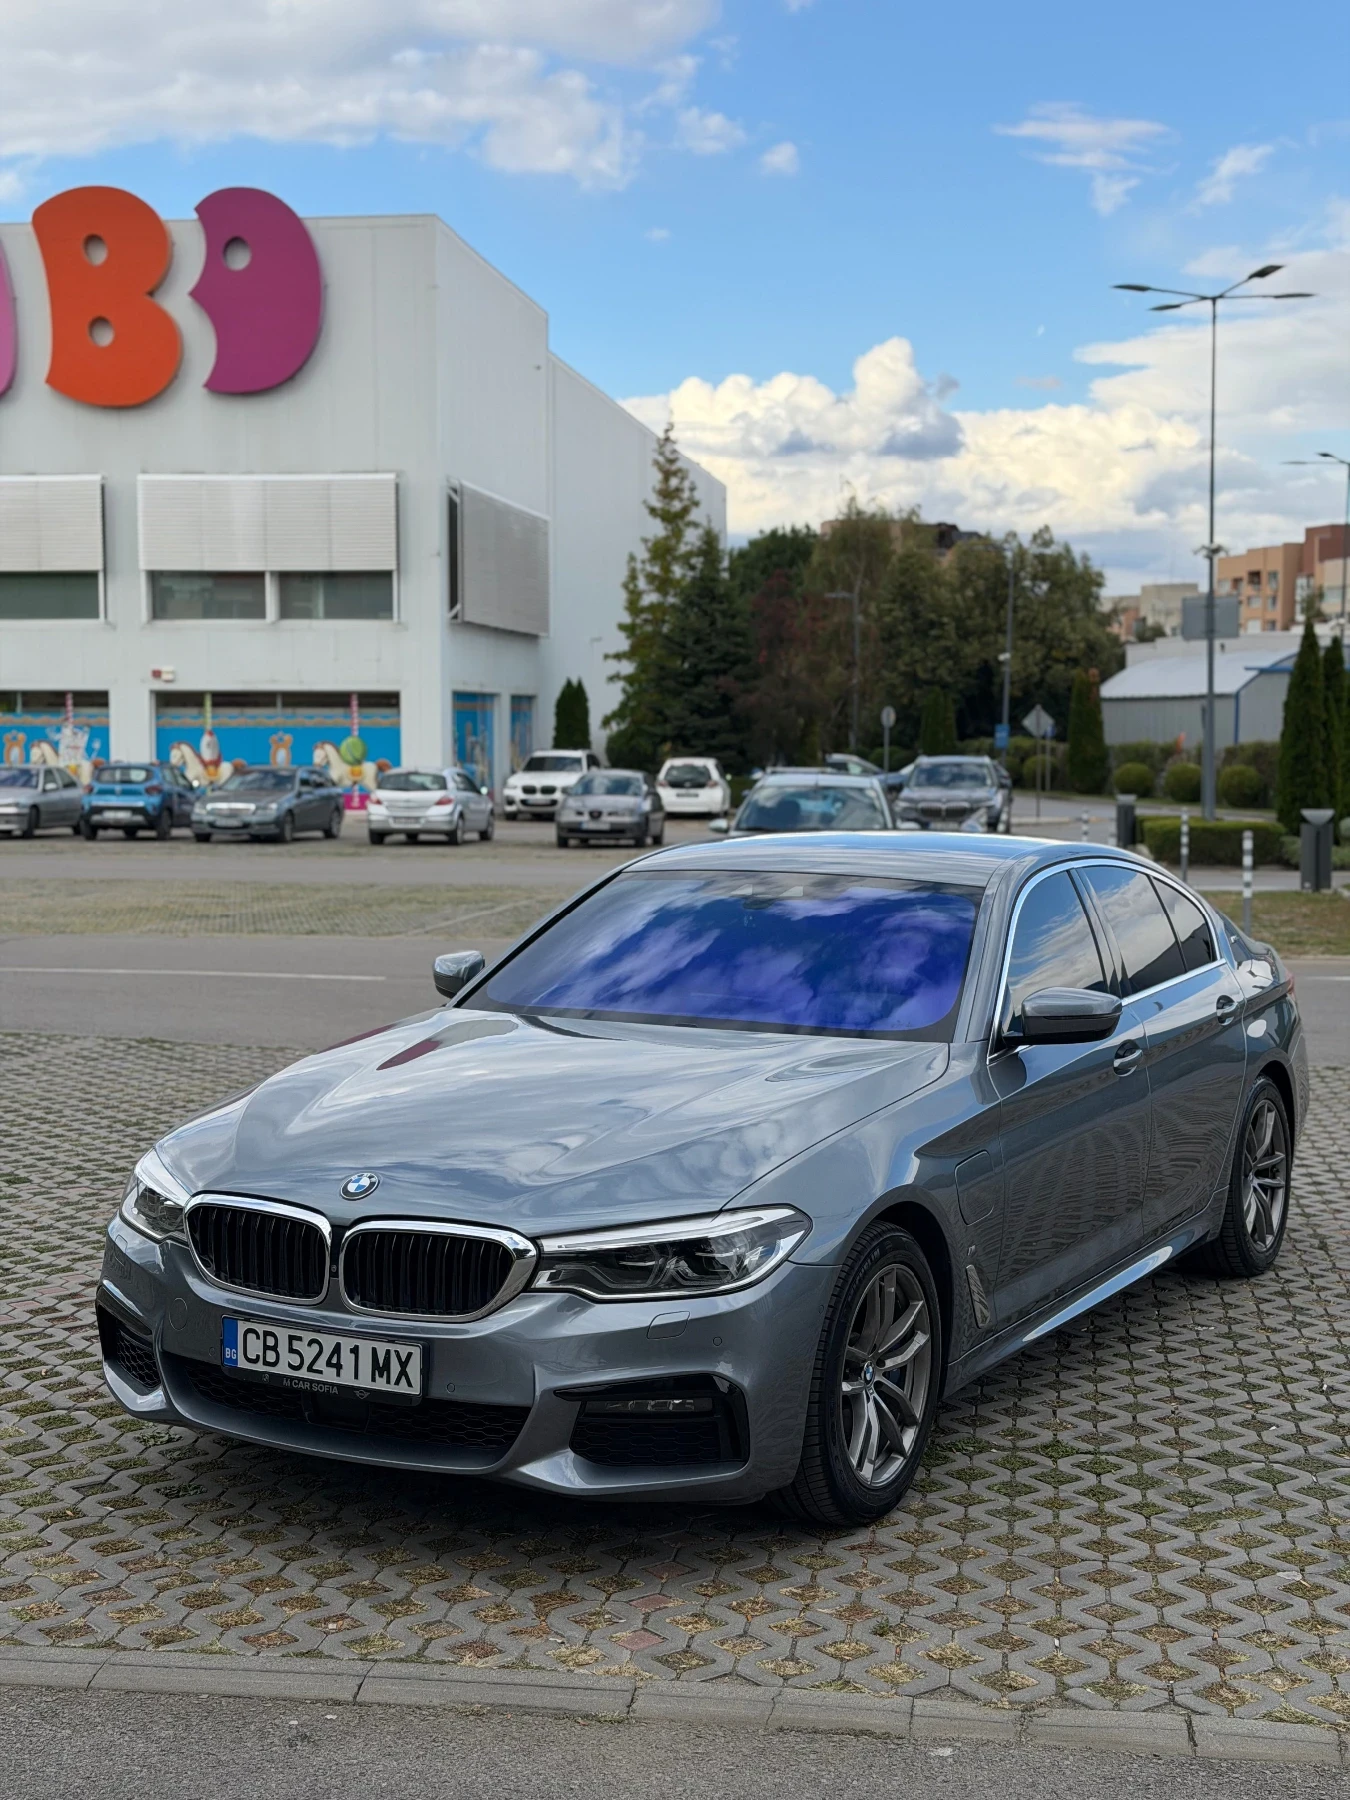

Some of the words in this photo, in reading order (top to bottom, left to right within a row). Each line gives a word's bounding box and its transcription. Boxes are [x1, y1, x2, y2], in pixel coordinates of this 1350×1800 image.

[225, 1347, 237, 1359] BG
[242, 1327, 280, 1368] CB
[287, 1334, 360, 1380] 5241
[370, 1346, 414, 1389] MX
[292, 1380, 310, 1391] CAR
[312, 1383, 339, 1395] SOFIA
